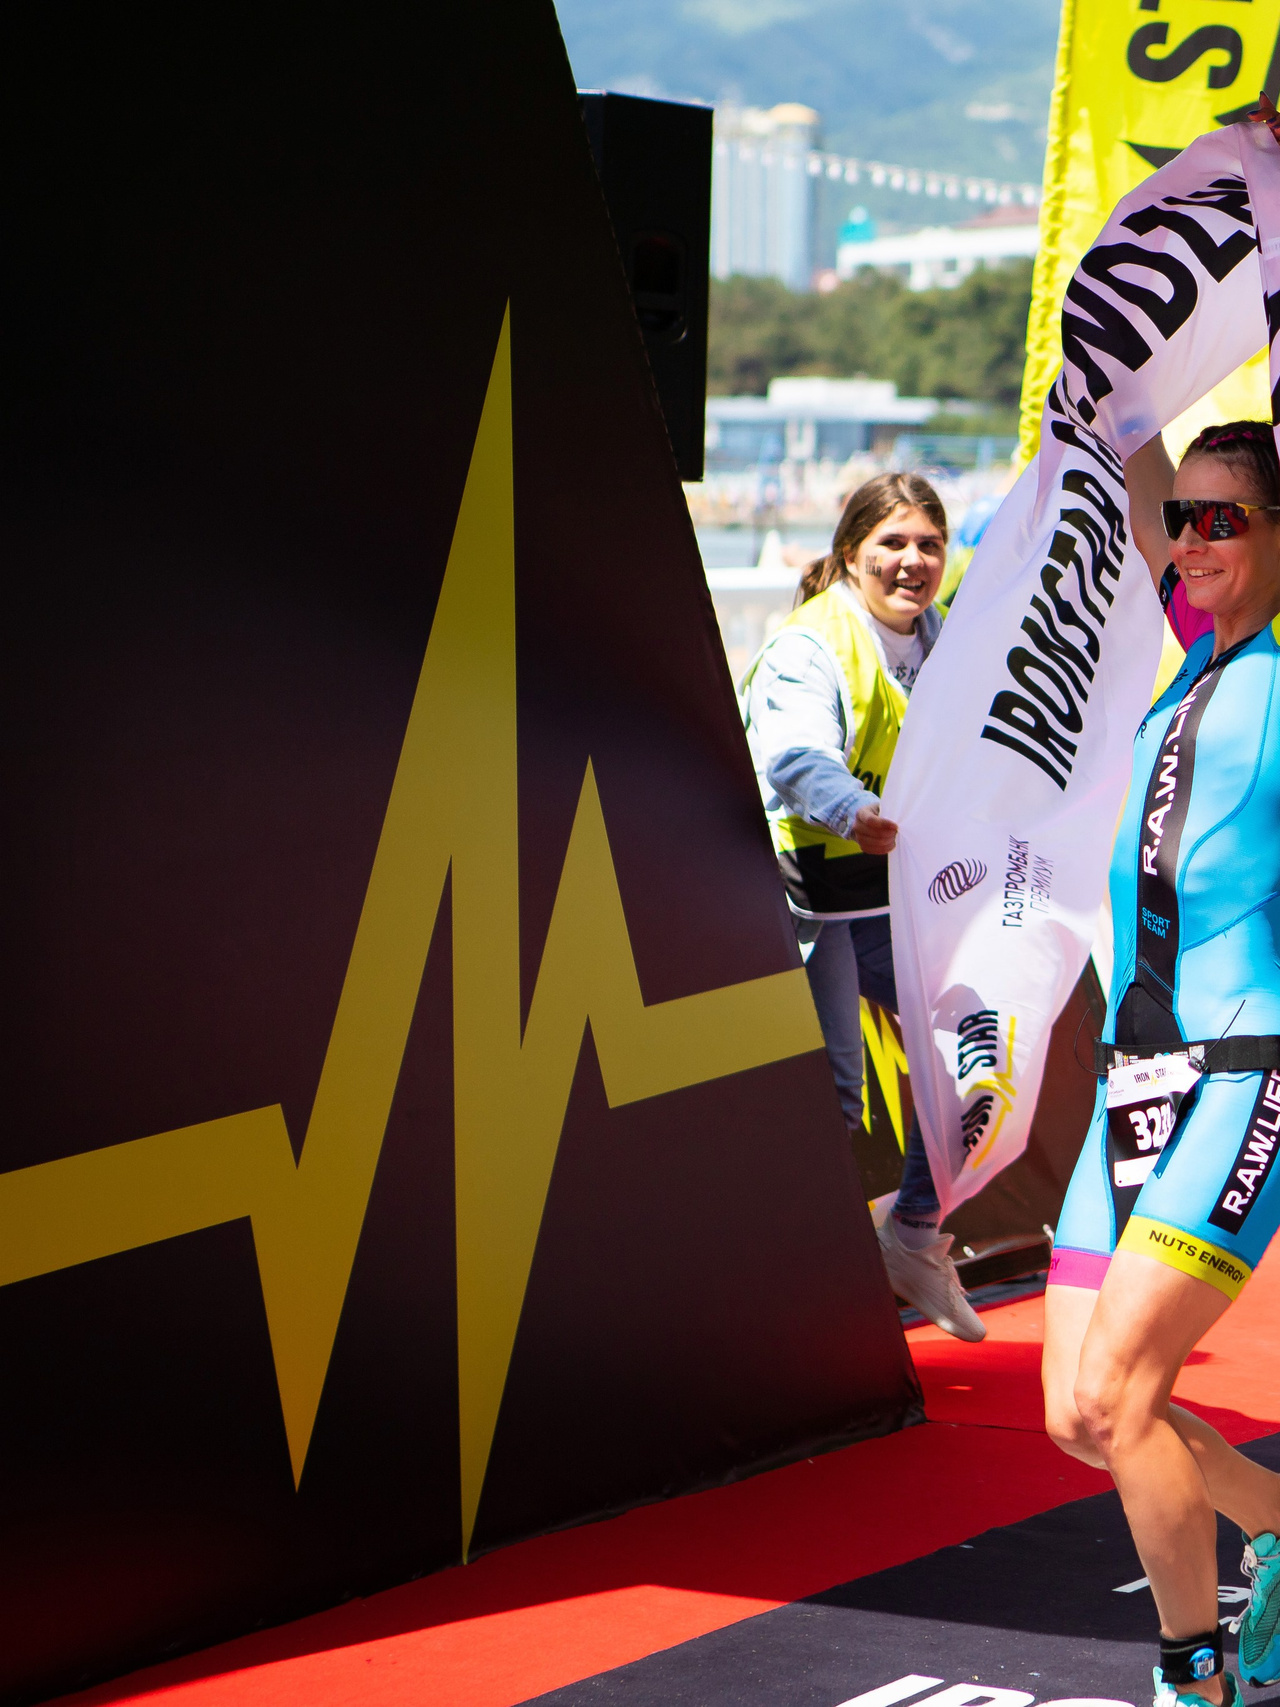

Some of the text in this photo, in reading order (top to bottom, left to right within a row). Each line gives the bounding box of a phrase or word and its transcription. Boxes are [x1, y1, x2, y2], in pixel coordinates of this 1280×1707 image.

[980, 469, 1128, 792] IRONSTAR
[1141, 915, 1166, 939] TEAM
[1142, 906, 1171, 930] SPORT
[957, 1009, 999, 1080] STAR
[1148, 1229, 1246, 1285] NUTS ENERGY
